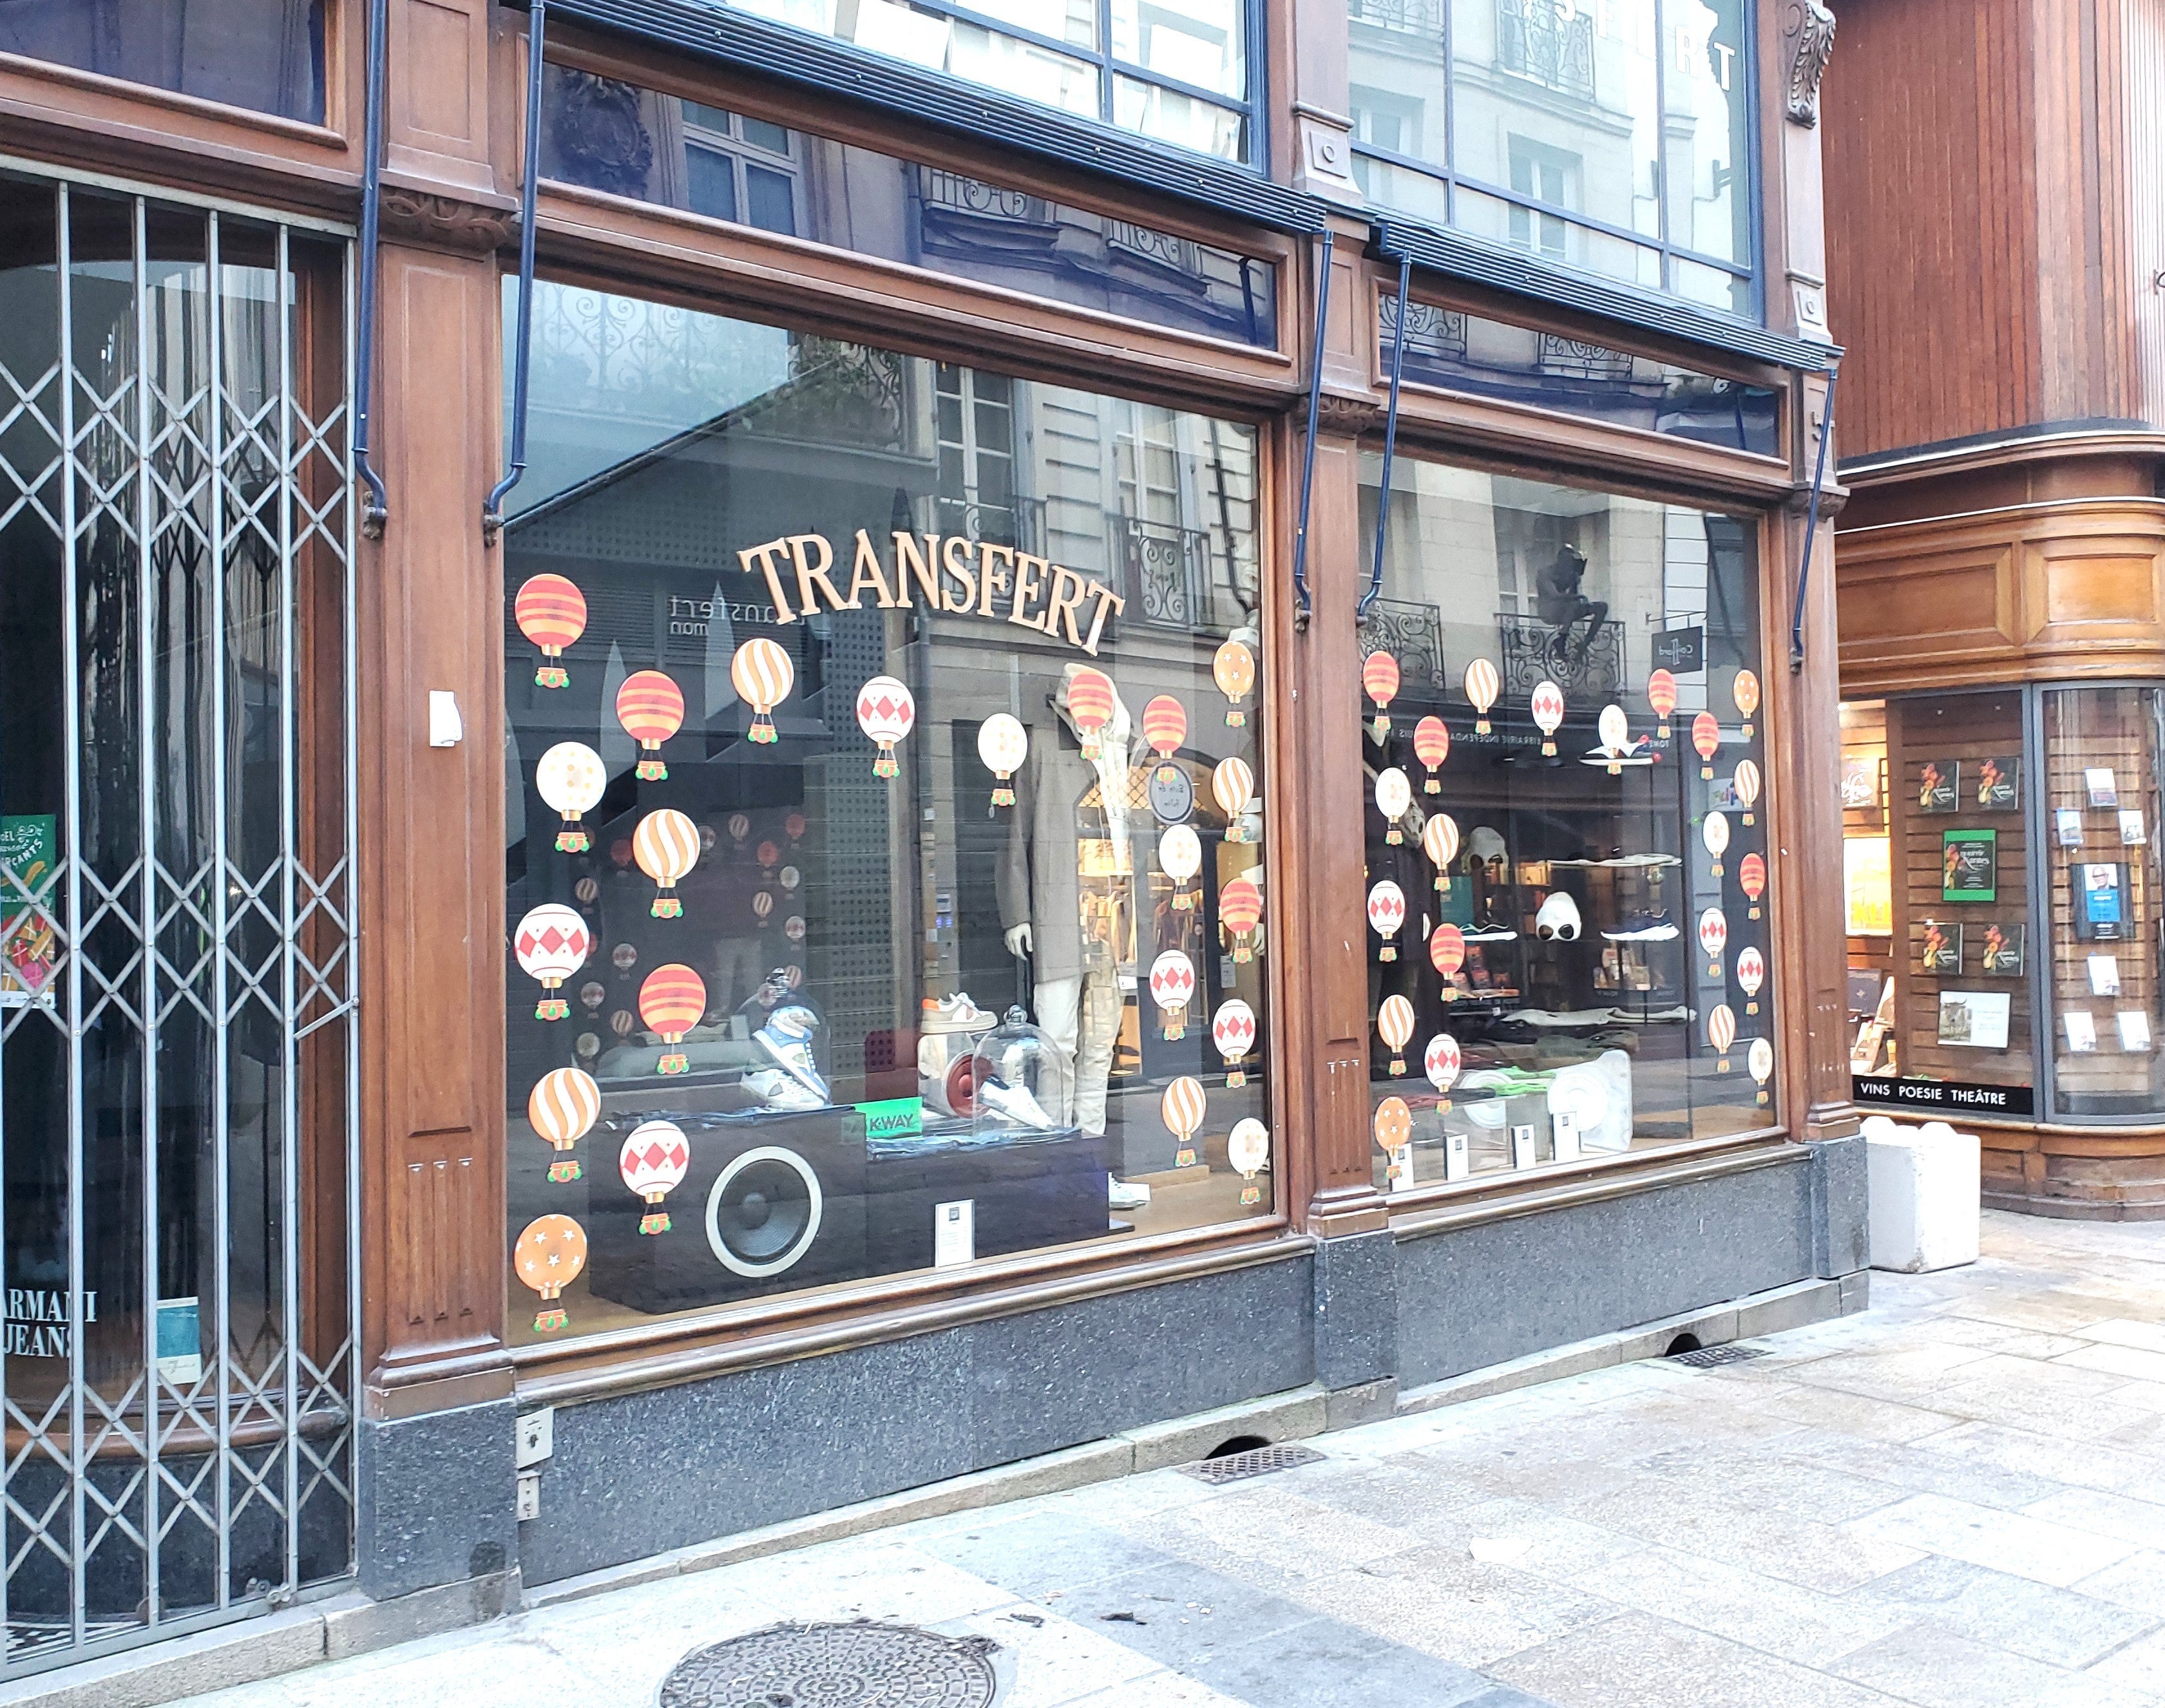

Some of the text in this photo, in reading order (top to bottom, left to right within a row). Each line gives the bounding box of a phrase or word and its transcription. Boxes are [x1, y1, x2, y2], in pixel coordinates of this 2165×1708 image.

[737, 528, 1126, 658] TRANSFERT
[1860, 1082, 2007, 1105] VINS POESIE THEÂTRE
